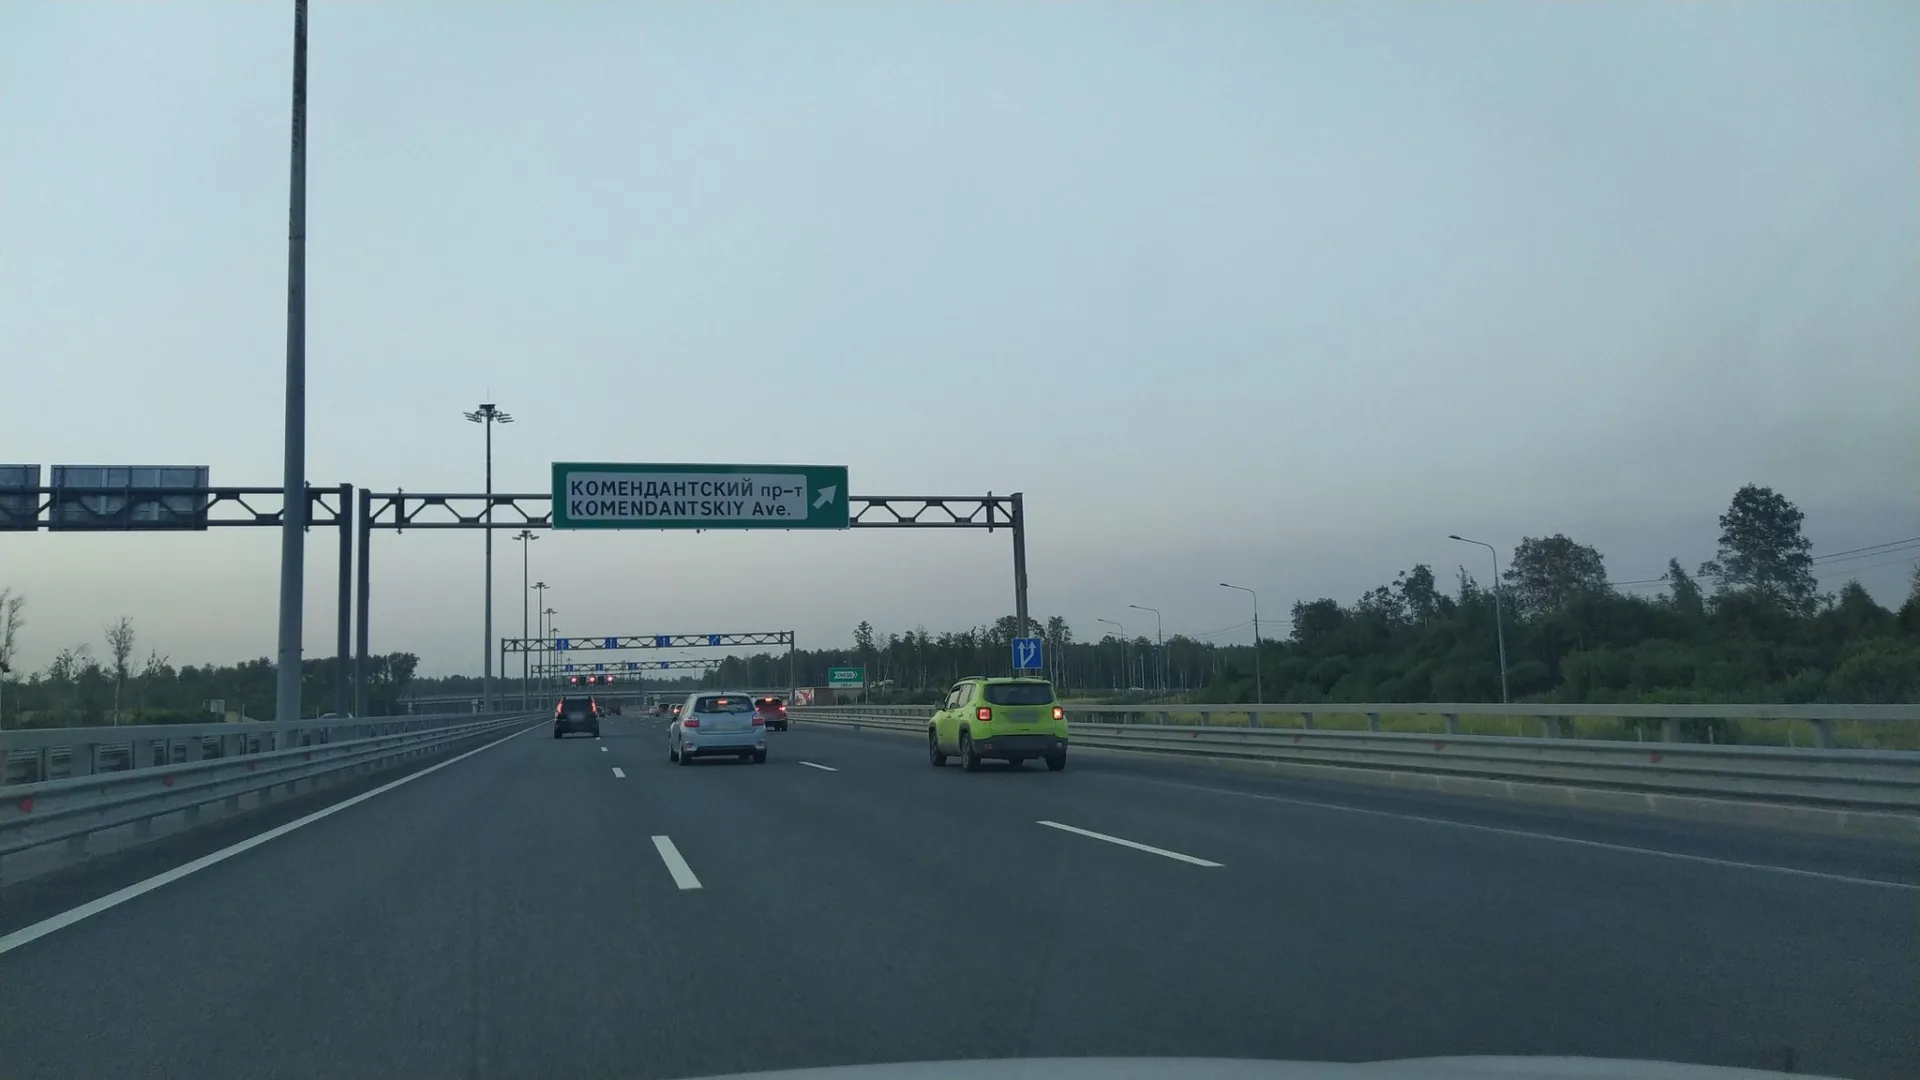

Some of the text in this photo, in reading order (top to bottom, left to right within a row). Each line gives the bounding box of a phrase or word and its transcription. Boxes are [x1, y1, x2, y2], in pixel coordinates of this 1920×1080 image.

[571, 478, 803, 500] КОМЕНДАНТСКИЙ пр-т
[571, 501, 791, 516] KOMENDANTSKIY Ave.
